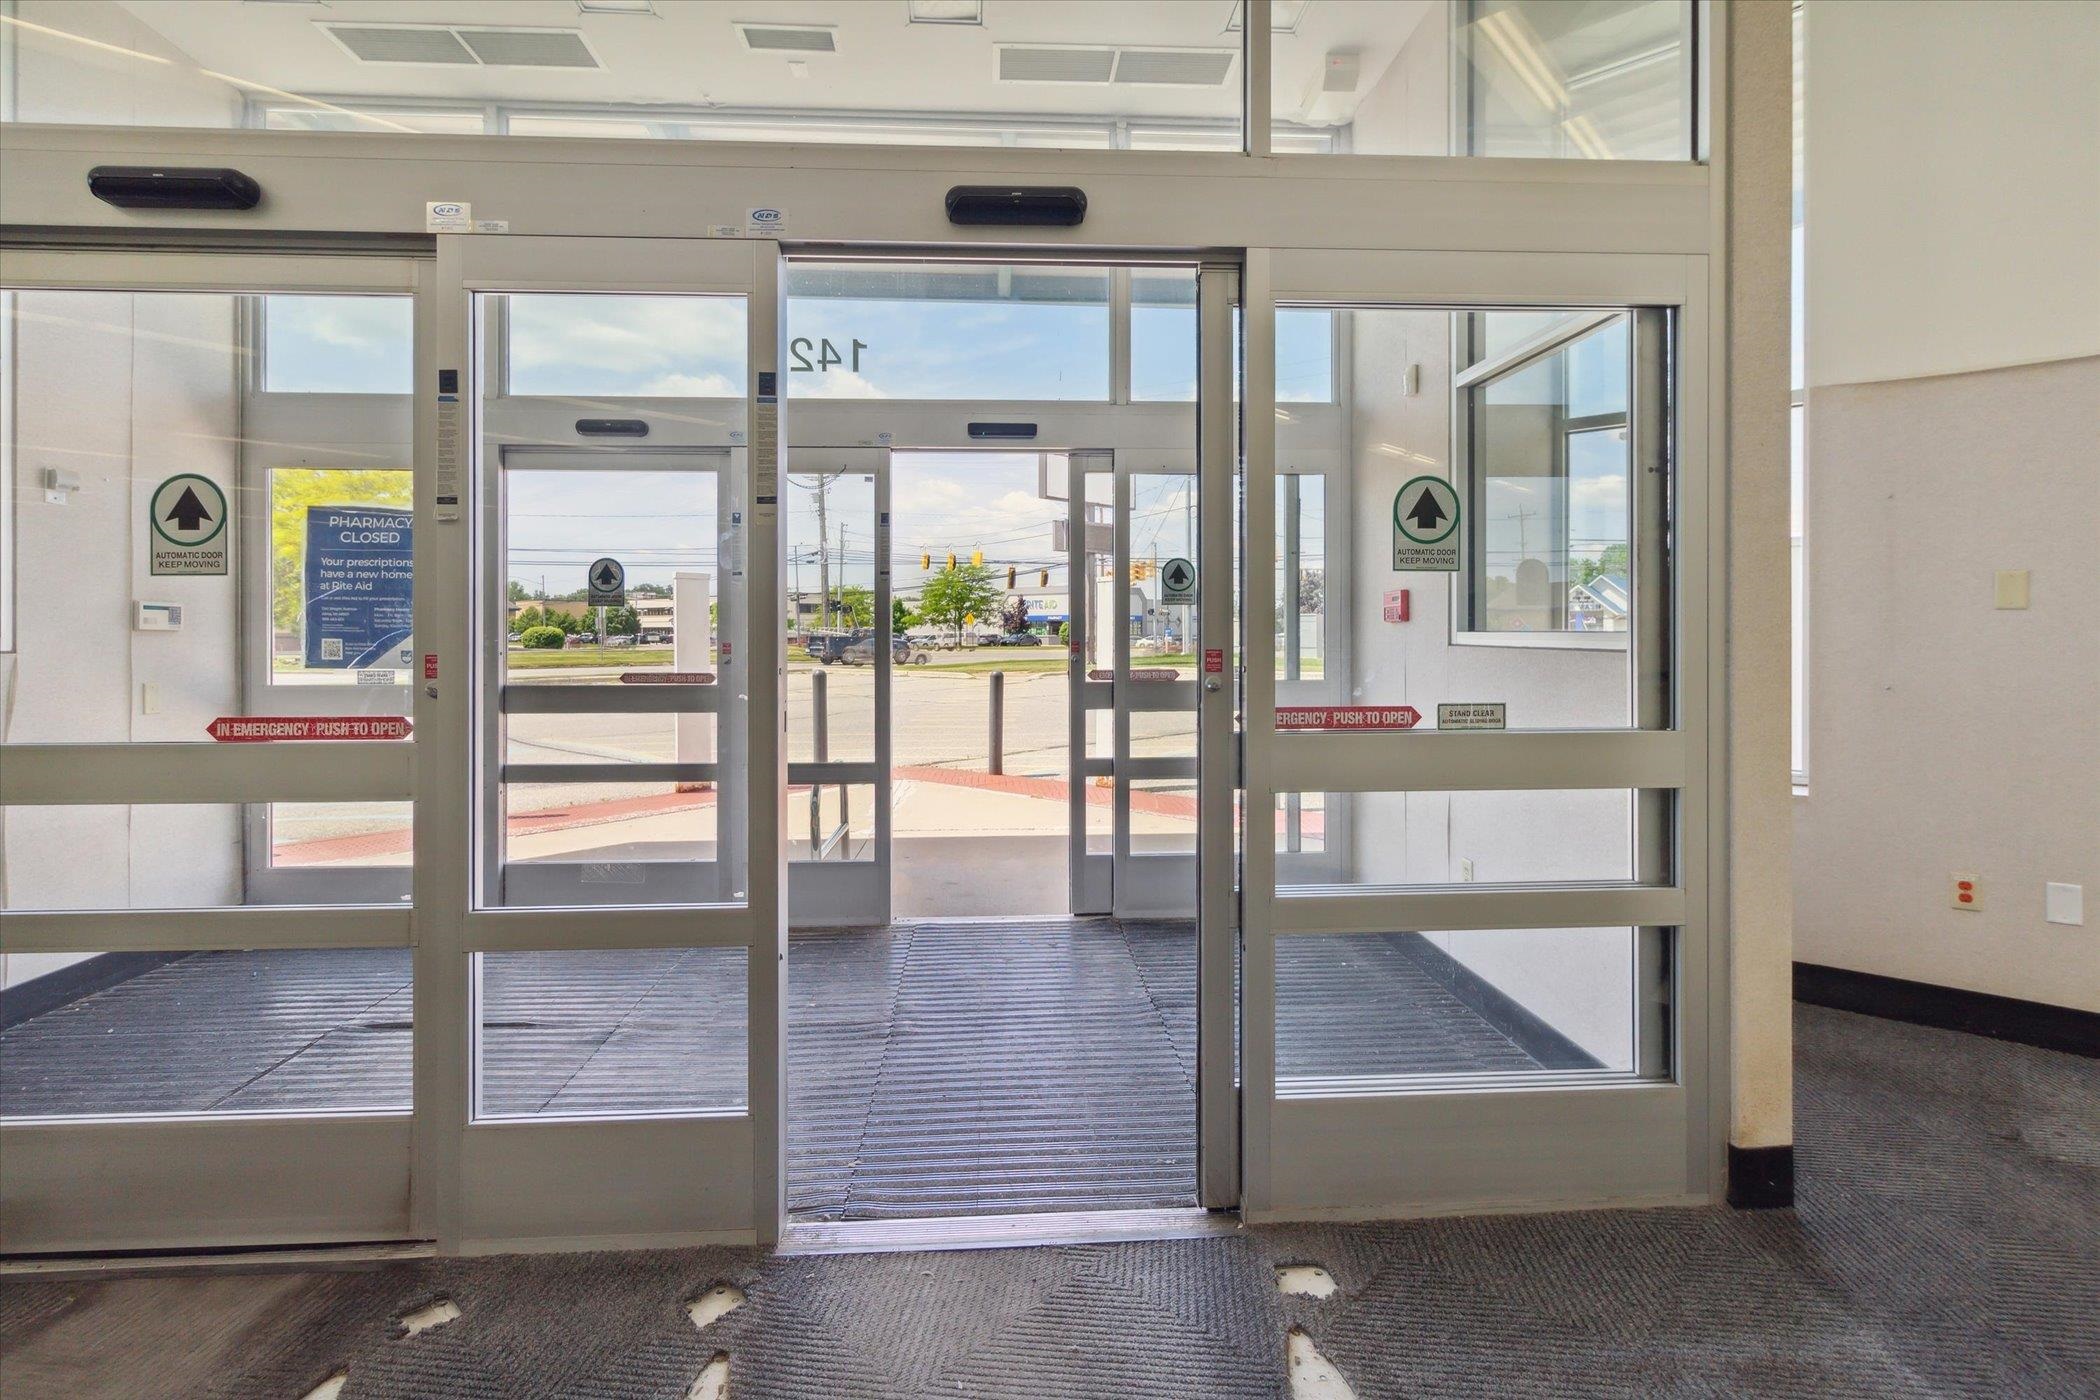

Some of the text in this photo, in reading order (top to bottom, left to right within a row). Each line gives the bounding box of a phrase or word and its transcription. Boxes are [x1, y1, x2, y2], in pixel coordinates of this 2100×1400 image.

[329, 516, 413, 529] PHARMACY
[340, 531, 401, 544] CLOSED
[321, 557, 414, 568] Your prescriptions
[1400, 557, 1455, 565] KEEP MOVING
[320, 569, 345, 578] have
[381, 570, 414, 579] home
[320, 581, 373, 590] at Rite Aid
[1276, 711, 1413, 725] ERGENCY PUSH TO OPEN
[217, 722, 405, 737] IN EMERGENCY PUSH TO OPEN
